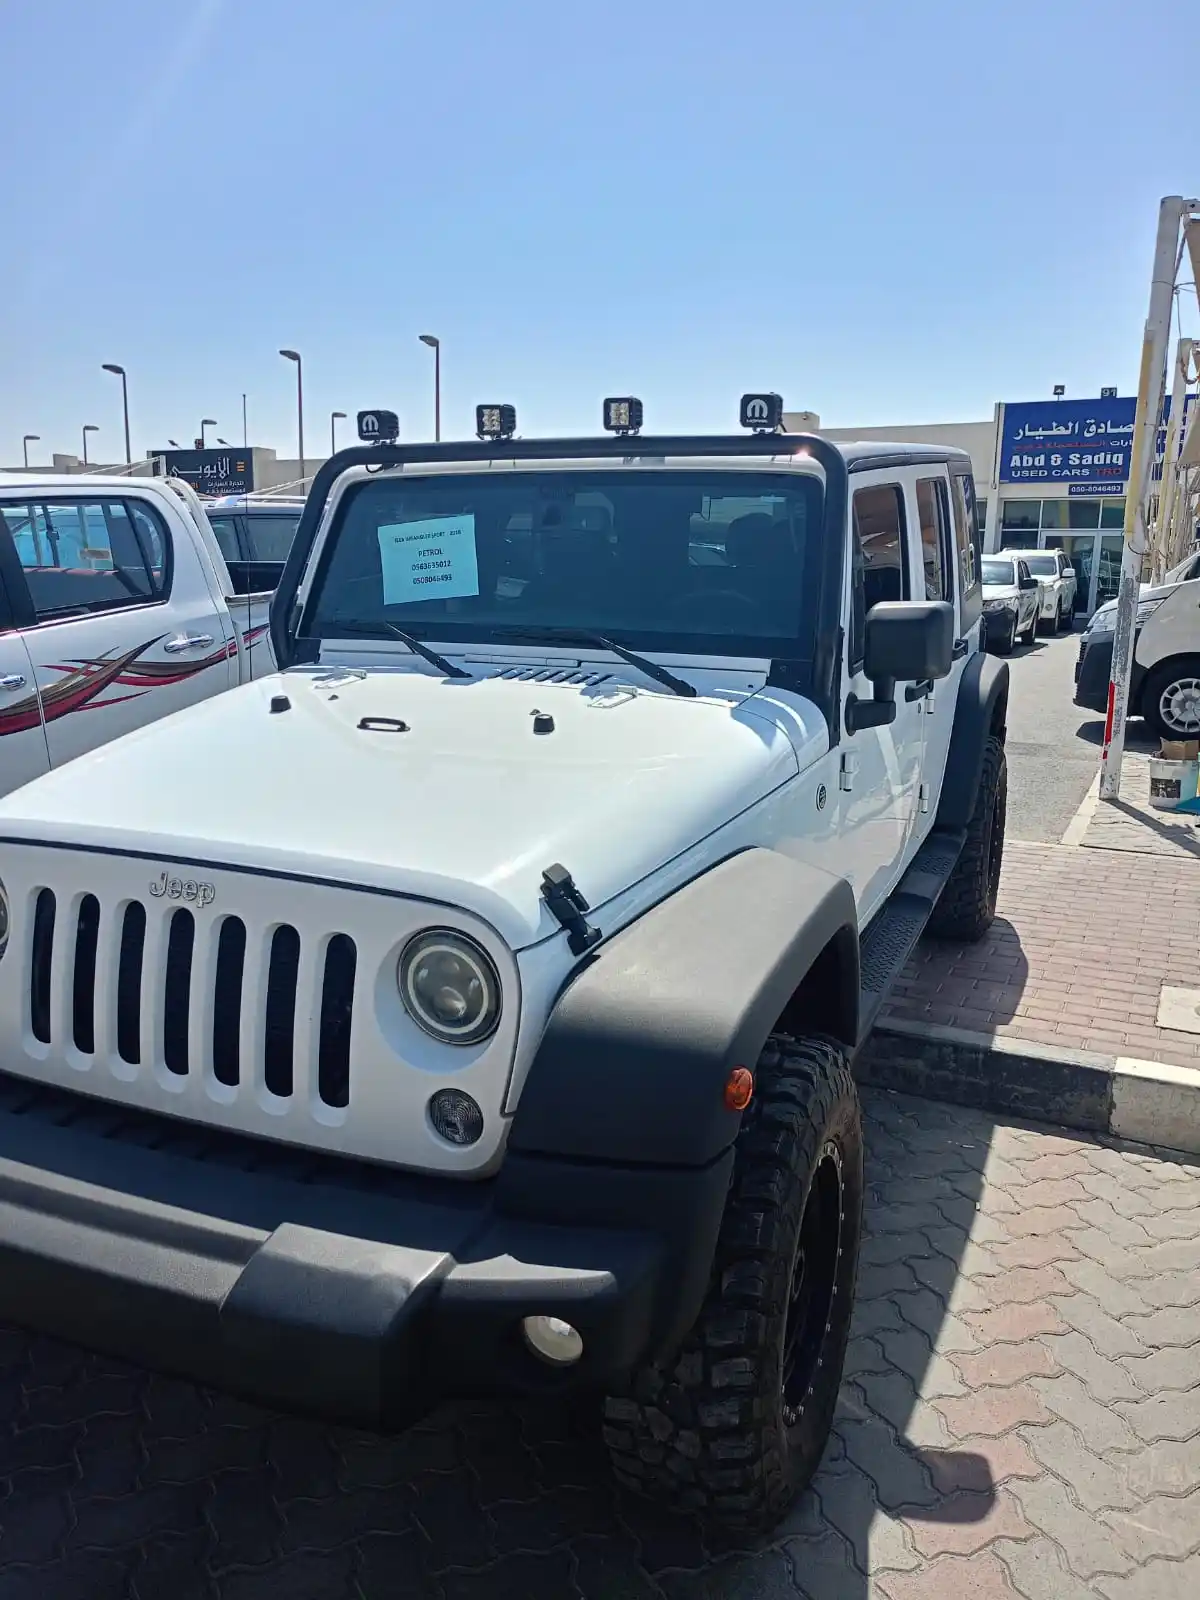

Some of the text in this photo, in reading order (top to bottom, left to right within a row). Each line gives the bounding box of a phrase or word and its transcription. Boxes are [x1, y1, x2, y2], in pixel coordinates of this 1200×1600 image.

[1013, 421, 1079, 440] الطيار
[1010, 452, 1124, 467] Abd & Sadiq
[1011, 469, 1048, 478] USED
[1052, 468, 1090, 477] CARS
[418, 548, 444, 558] PETROL
[149, 870, 216, 909] Jeep
